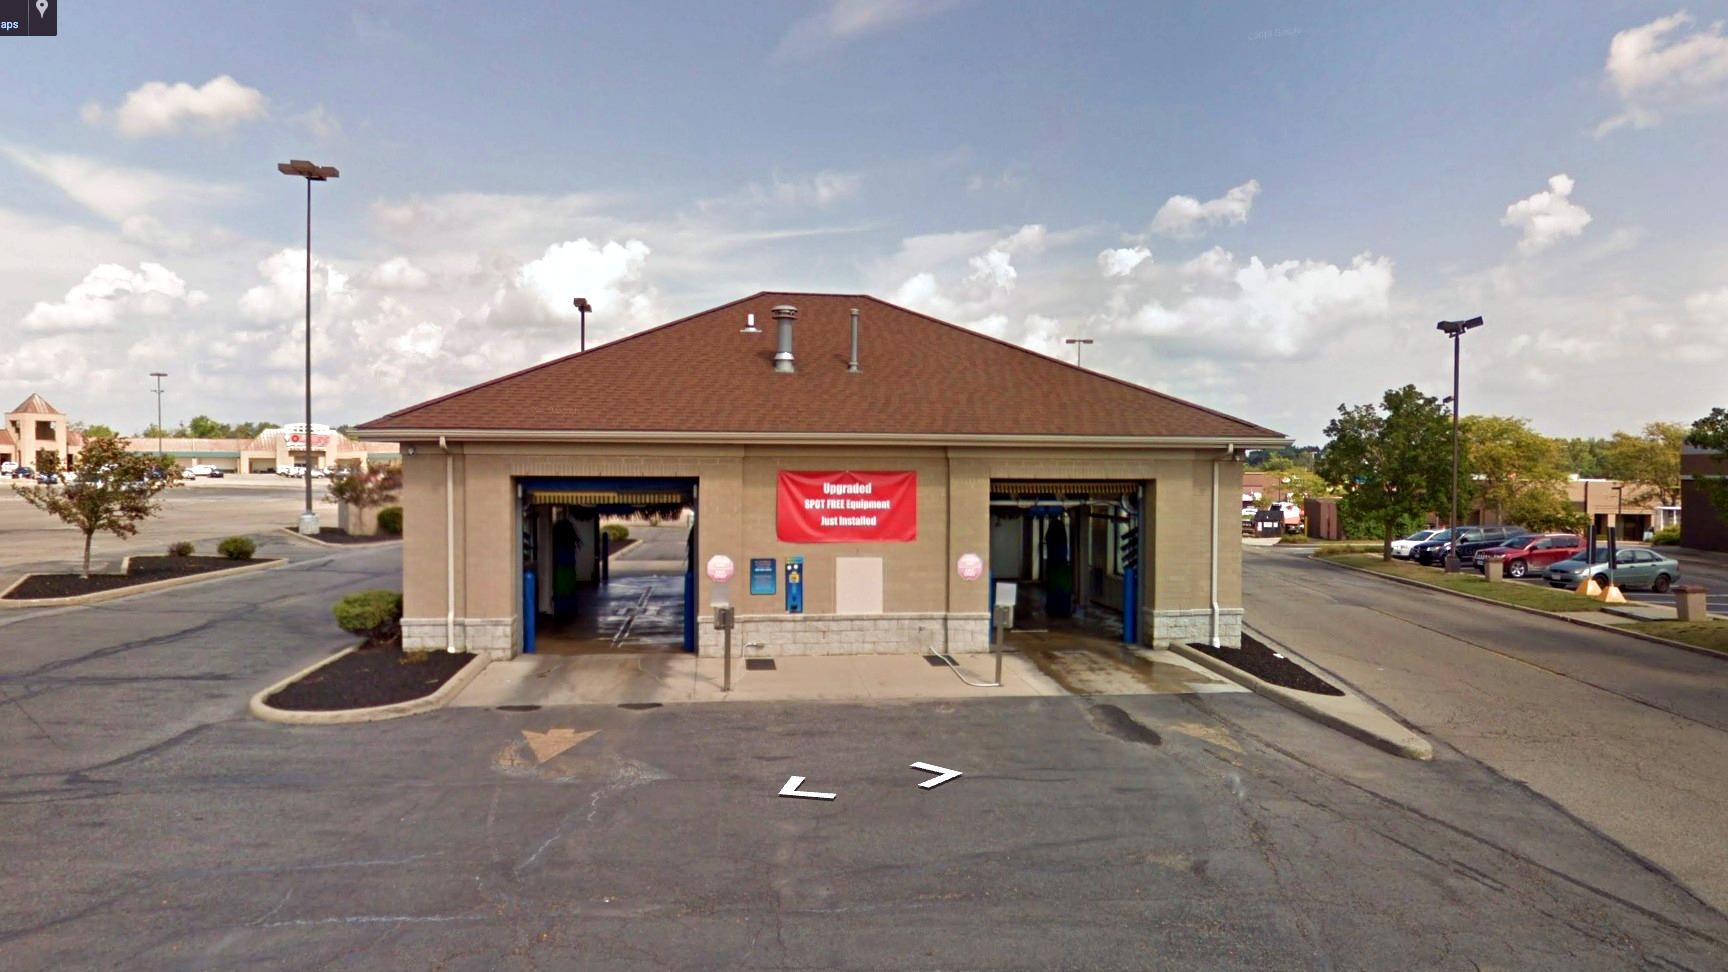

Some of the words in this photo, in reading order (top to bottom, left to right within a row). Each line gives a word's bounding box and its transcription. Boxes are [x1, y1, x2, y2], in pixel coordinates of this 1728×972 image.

[823, 482, 872, 496] Upgraded
[804, 499, 825, 510] SPOT
[826, 499, 845, 510] FREE
[846, 499, 891, 511] Equipment
[821, 516, 838, 526] Just
[839, 516, 877, 526] Installed
